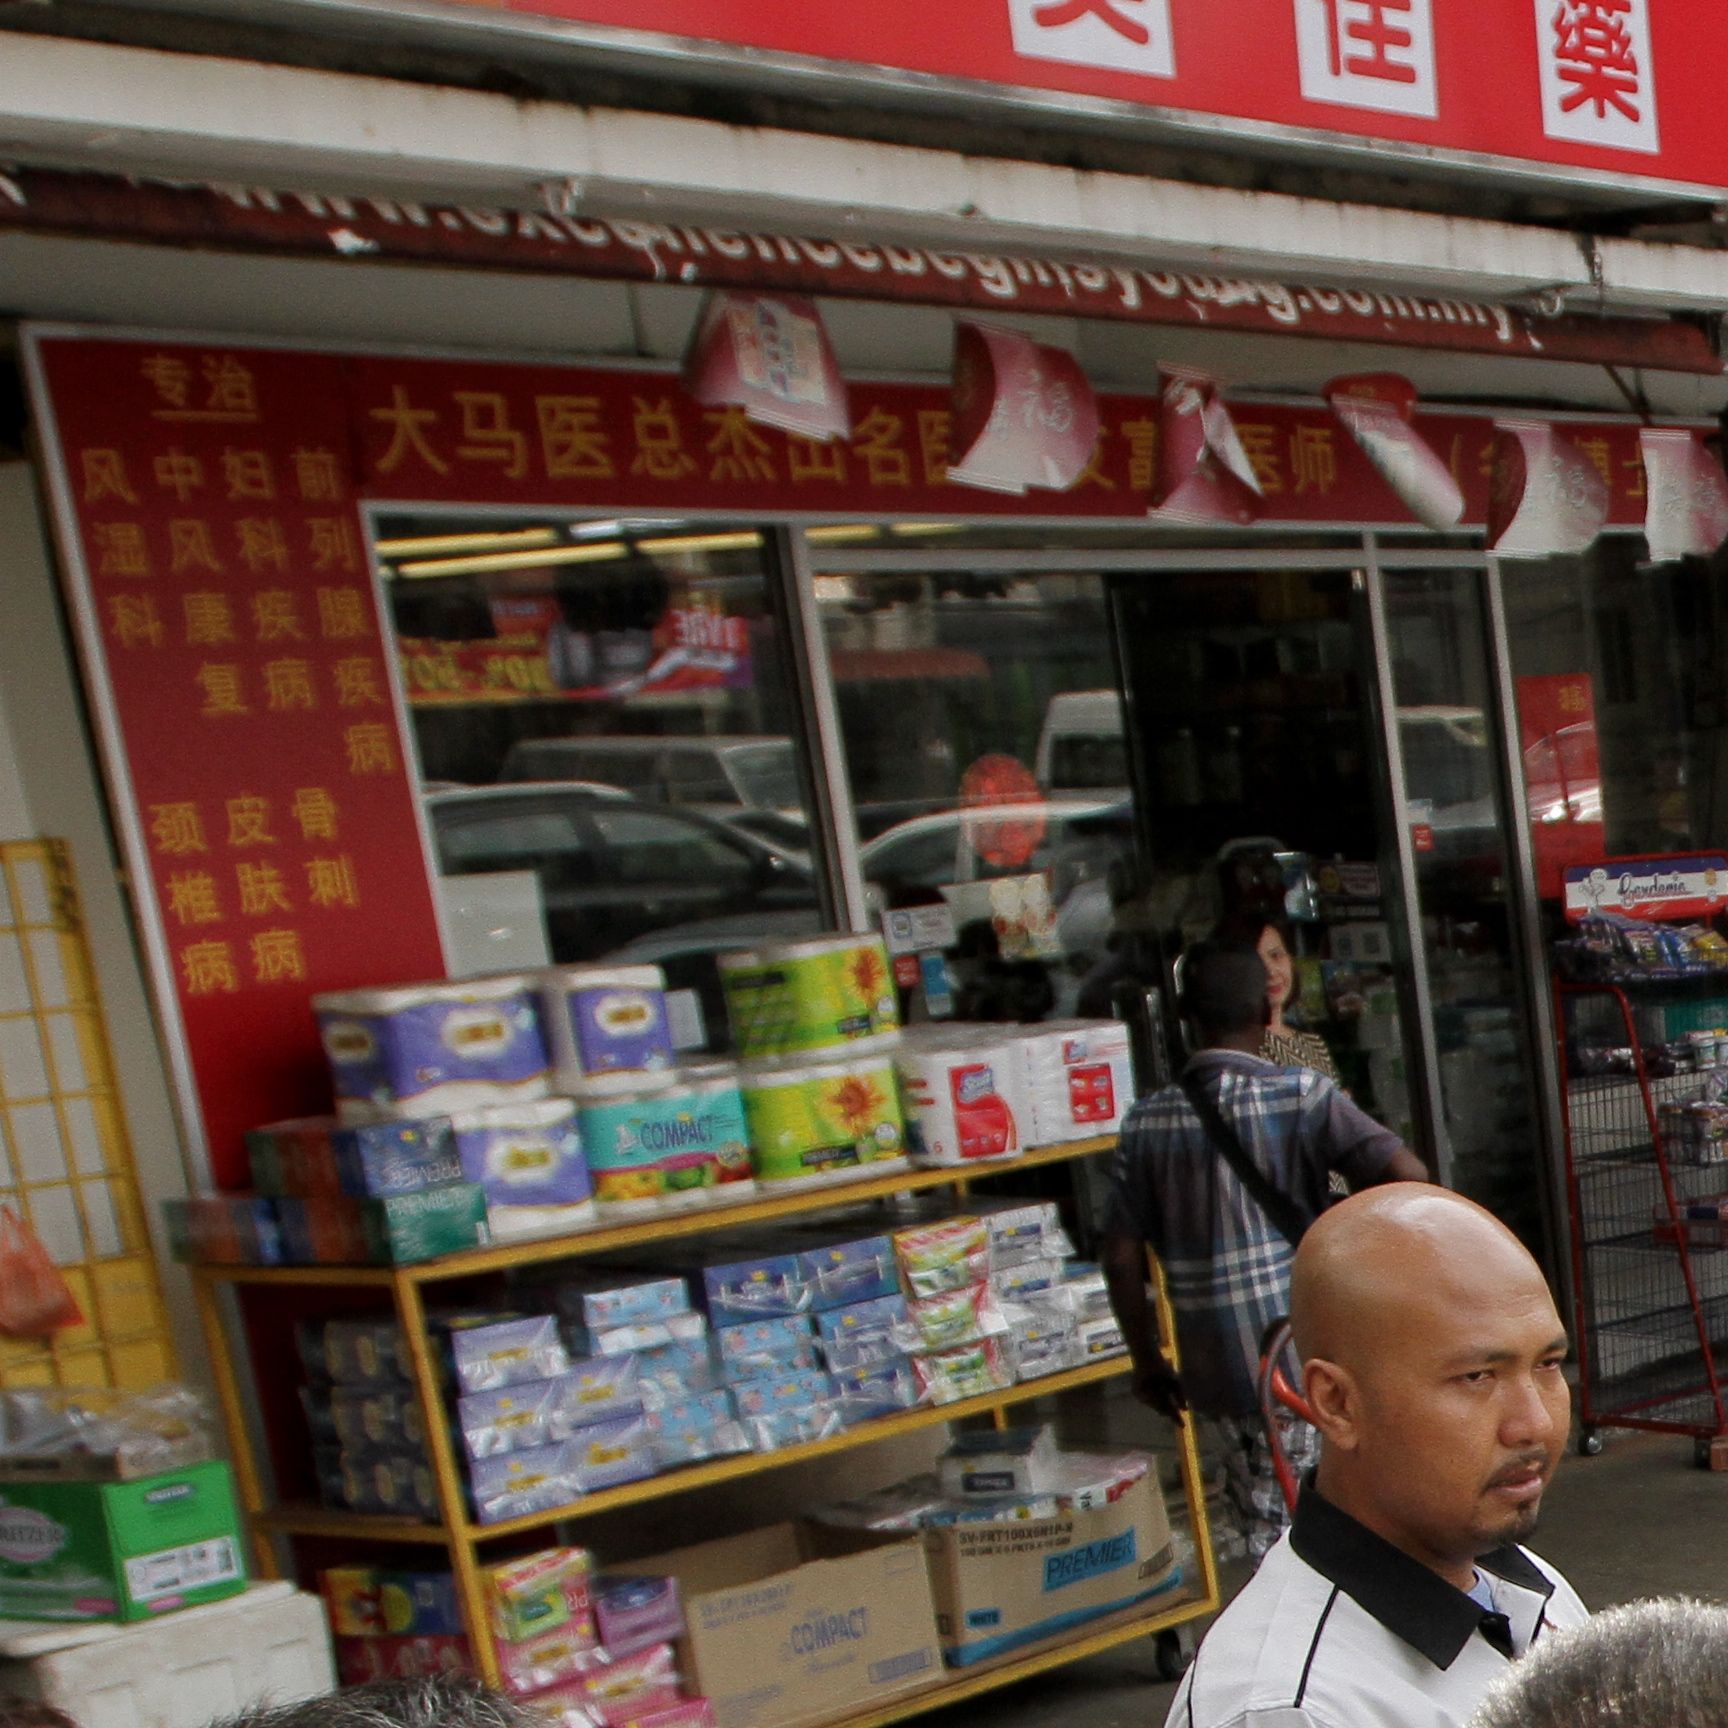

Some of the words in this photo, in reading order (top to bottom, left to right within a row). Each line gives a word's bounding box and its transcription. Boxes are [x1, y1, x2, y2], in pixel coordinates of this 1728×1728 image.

[142, 353, 256, 413] 专治
[81, 447, 164, 650] 风湿科
[153, 452, 248, 717] 中风康复
[222, 448, 312, 711] 妇科疾病
[292, 447, 393, 776] 前列腺疾病
[149, 800, 239, 996] 颈椎病
[226, 796, 306, 984] 皮肤病
[291, 787, 358, 909] 骨刺
[1617, 872, 1692, 909] Gardenia
[641, 1118, 713, 1151] COMPACT
[790, 1606, 867, 1655] COMPACT
[1046, 1532, 1133, 1583] PREMIER
